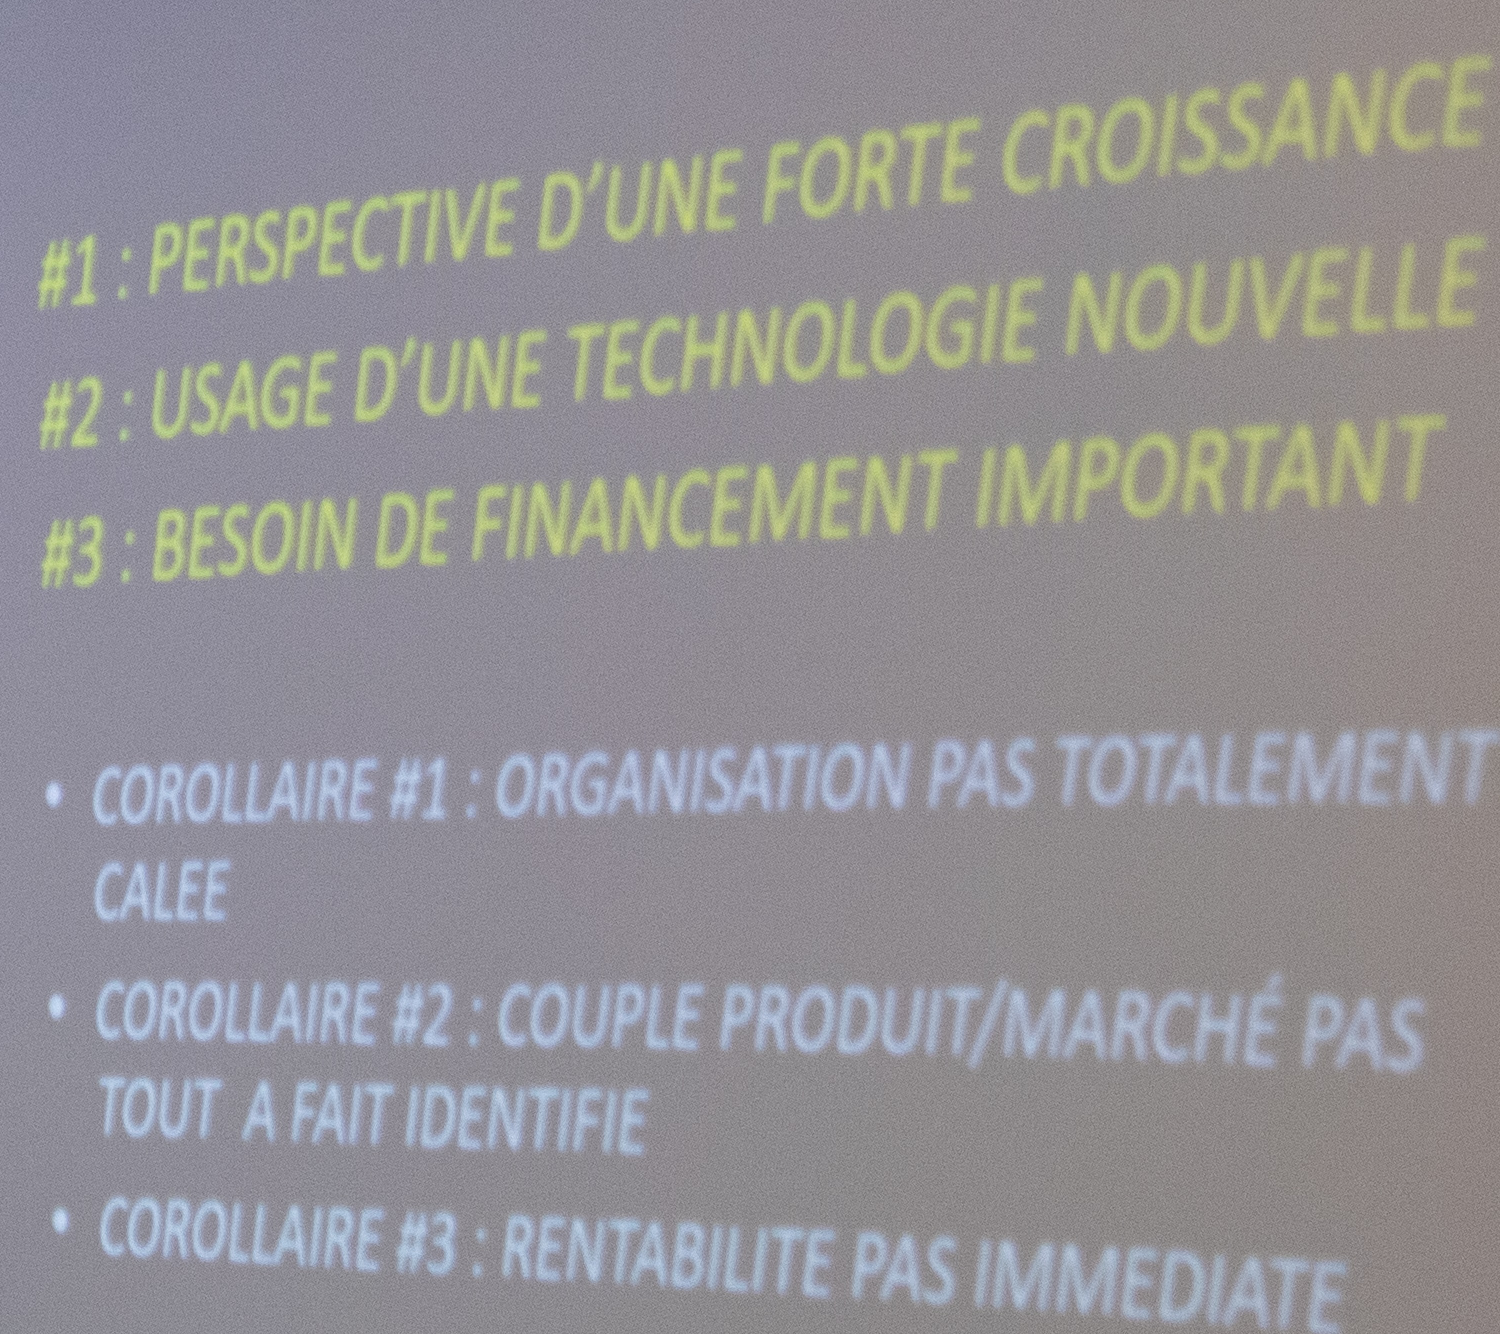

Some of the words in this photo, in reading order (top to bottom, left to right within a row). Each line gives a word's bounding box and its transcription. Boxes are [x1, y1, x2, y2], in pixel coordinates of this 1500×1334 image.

[37, 235, 99, 310] #1
[147, 177, 519, 298] PERSPECTIVE
[537, 149, 742, 253] D'UNE
[761, 117, 982, 227] FORTE
[1001, 53, 1493, 195] CROISSANCE
[40, 377, 103, 452] #2
[151, 352, 338, 441] USAGE
[353, 328, 547, 425] D'UNE
[568, 276, 1042, 402] TECHNOLOGIE
[1065, 233, 1490, 357] NOUVELLE
[42, 516, 104, 590] #3
[151, 497, 357, 584] BESOIN
[374, 488, 454, 572] DE
[471, 448, 958, 563] FINANCEMENT
[977, 412, 1448, 530] IMPORTANT
[92, 758, 377, 826] COROLLAIRE
[388, 756, 448, 820] #1
[495, 741, 910, 819] ORGANISATION
[926, 738, 1035, 810] PAS
[1056, 726, 1499, 808] TOTALEMENT
[93, 859, 230, 923] CALEE
[94, 980, 380, 1045] COROLLAIRE
[392, 982, 451, 1048] #2
[497, 982, 703, 1051] COUPLE
[720, 969, 1285, 1068] PRODUIT/MARCHÉ
[1299, 995, 1426, 1073] PAS
[97, 1077, 221, 1137] TOUT
[243, 1082, 277, 1141] A
[293, 1082, 396, 1147] FAIT
[405, 1085, 649, 1156] IDENTIFIE
[98, 1197, 382, 1271] COROLLAIRE
[394, 1210, 455, 1274] #3
[502, 1213, 834, 1297] RENTABILITE
[850, 1232, 956, 1307] PAS
